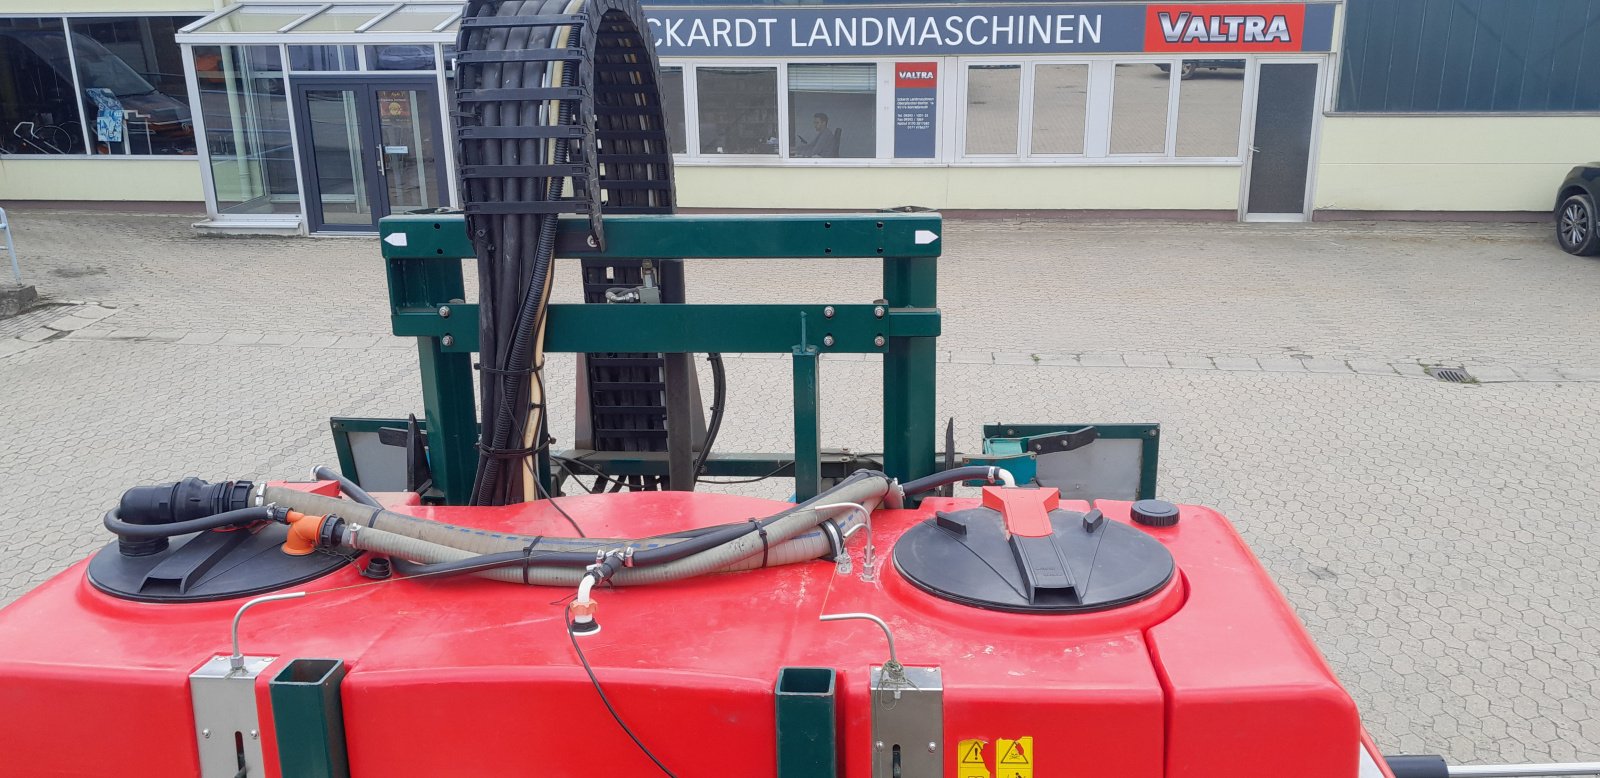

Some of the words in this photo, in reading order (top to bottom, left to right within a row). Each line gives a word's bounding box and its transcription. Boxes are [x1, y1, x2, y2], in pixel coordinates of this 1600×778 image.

[791, 14, 1102, 47] LANDMASCHINEN
[1157, 12, 1292, 43] VALTRA
[899, 71, 934, 79] VALTRA
